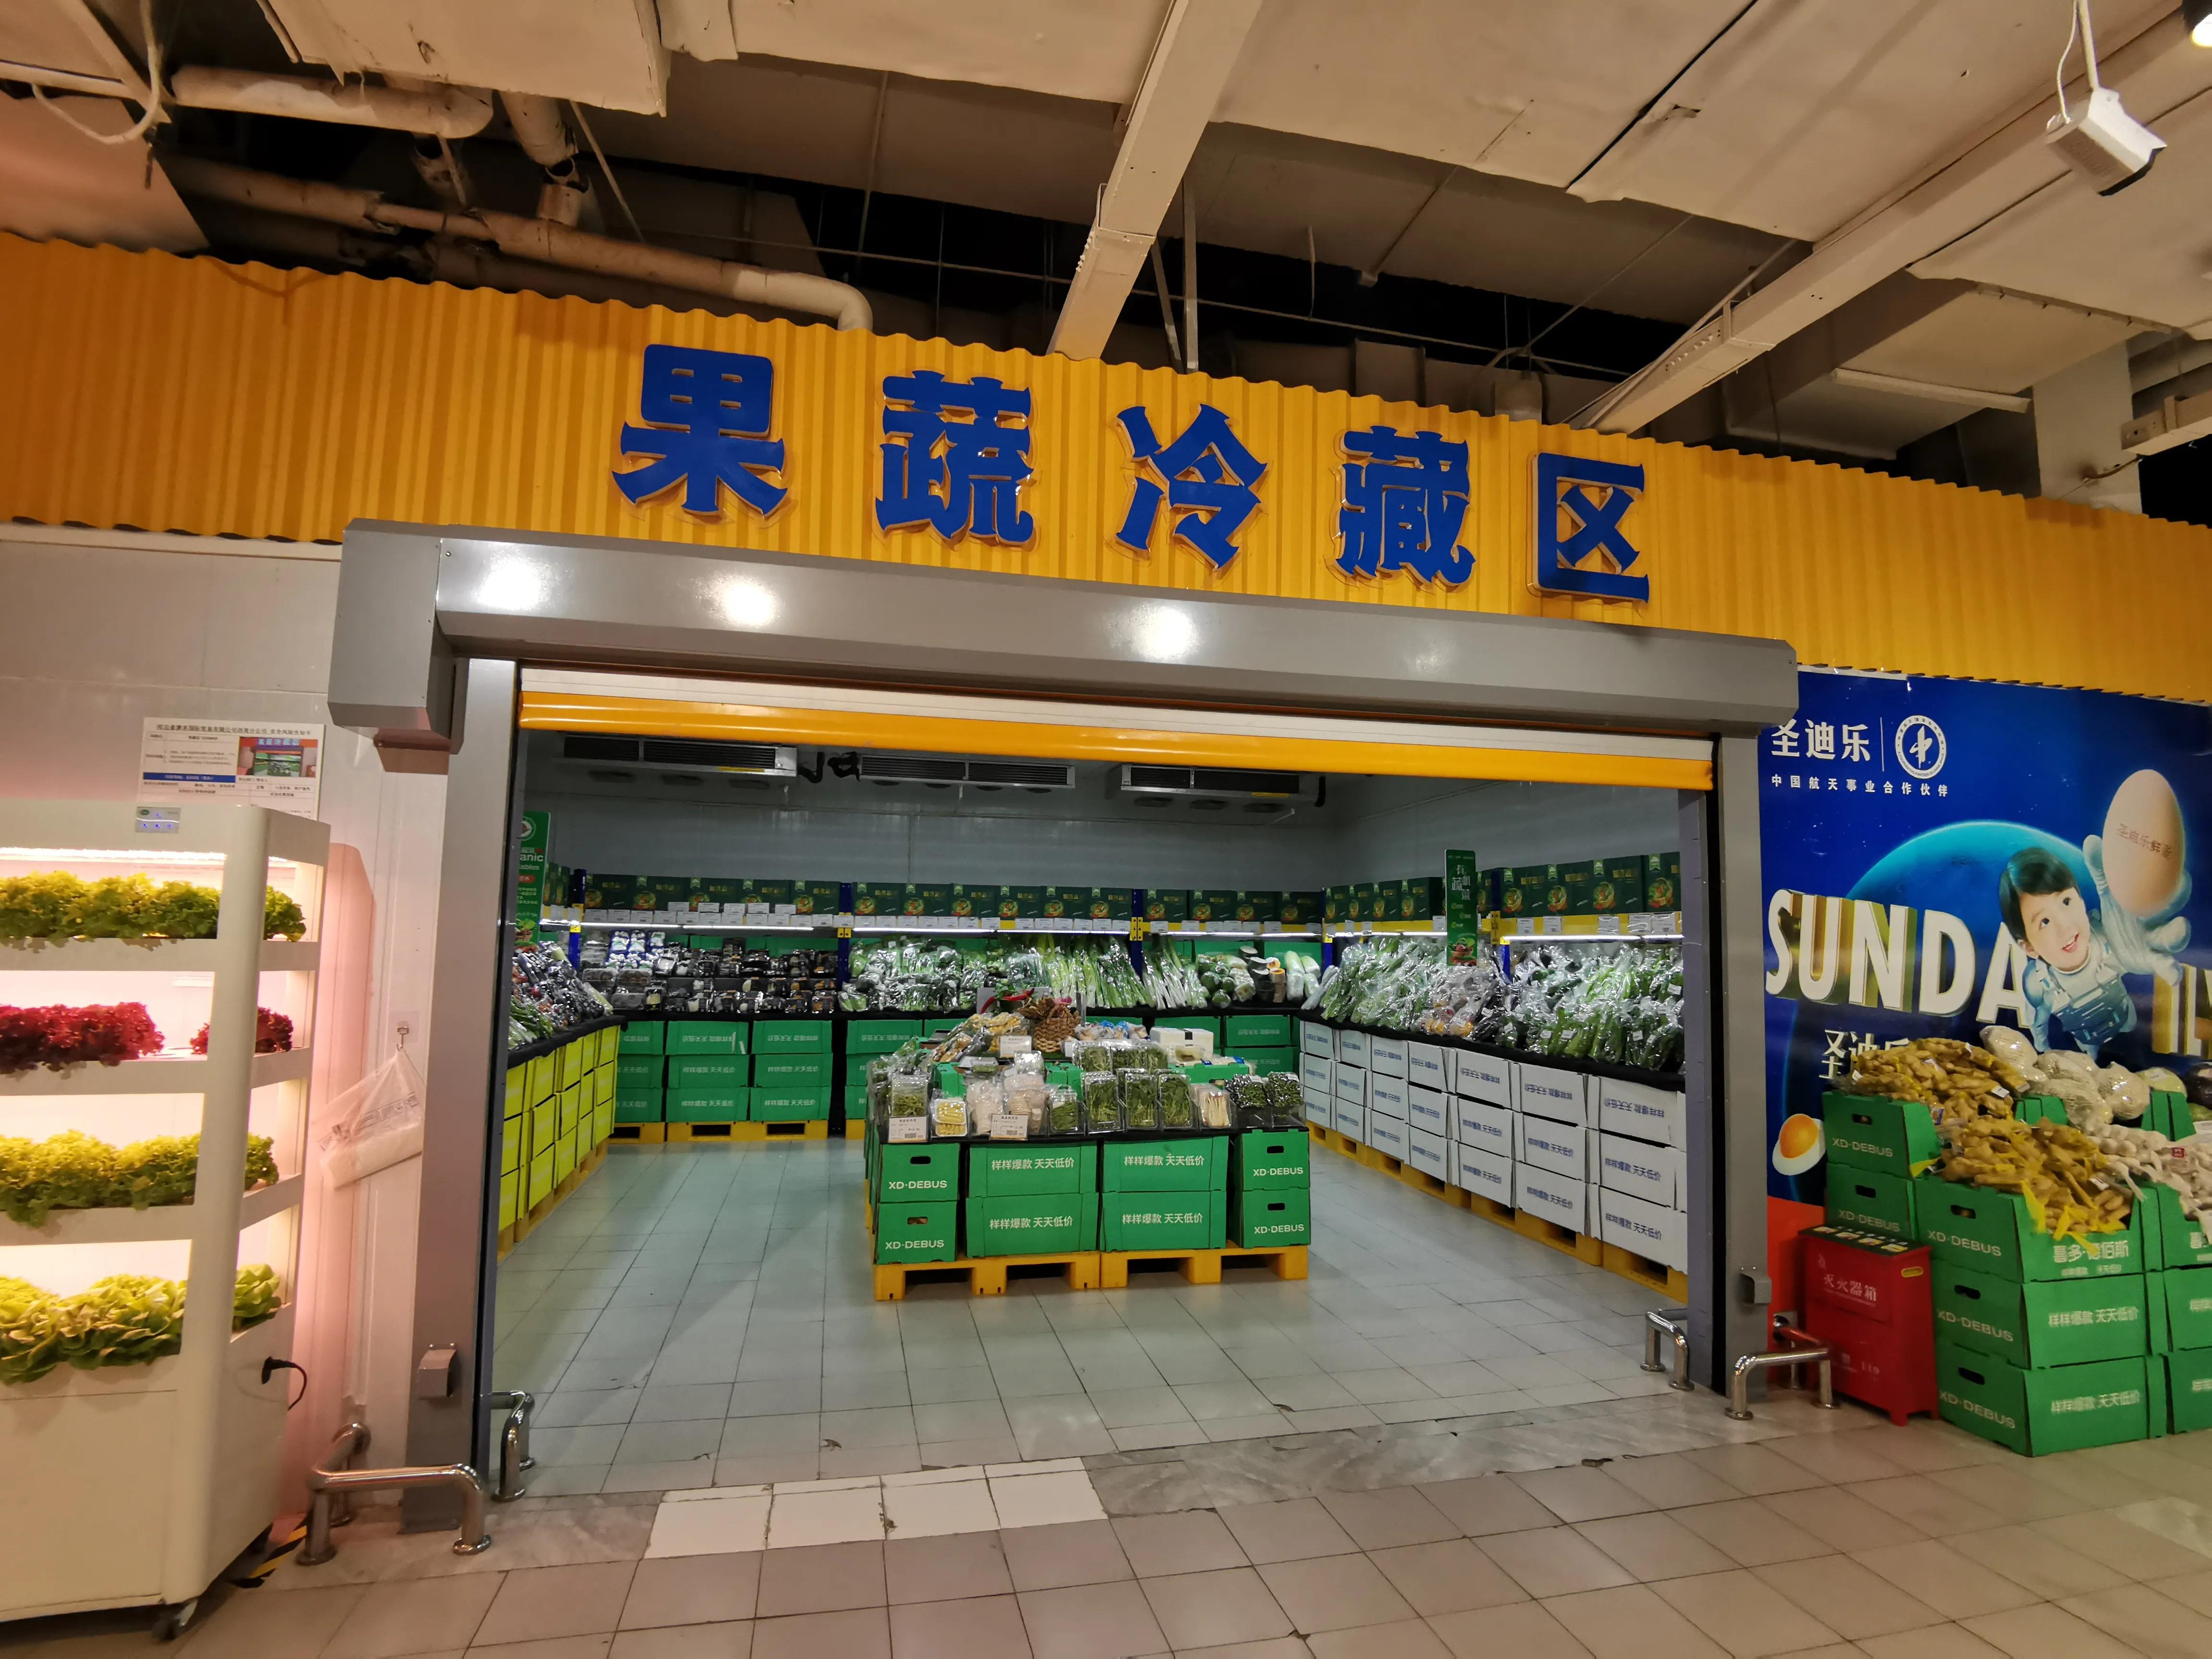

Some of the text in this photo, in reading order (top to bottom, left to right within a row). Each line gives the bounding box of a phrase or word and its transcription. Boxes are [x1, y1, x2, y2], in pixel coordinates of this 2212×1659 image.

[612, 343, 1651, 605] 果蔬冷藏区
[1771, 719, 1870, 762] 圣迪乐
[1771, 774, 1948, 797] 中国航天事业合作伙伴
[520, 853, 544, 862] anic
[991, 1156, 1075, 1171] 样样爆款 天天低价
[1124, 1154, 1205, 1166] 样样爆款 天天低价
[989, 1215, 1073, 1230] 样样爆款 天天低价
[1122, 1212, 1203, 1225] 样样爆款 天天低价
[1824, 1274, 1876, 1301] 灭火器箱
